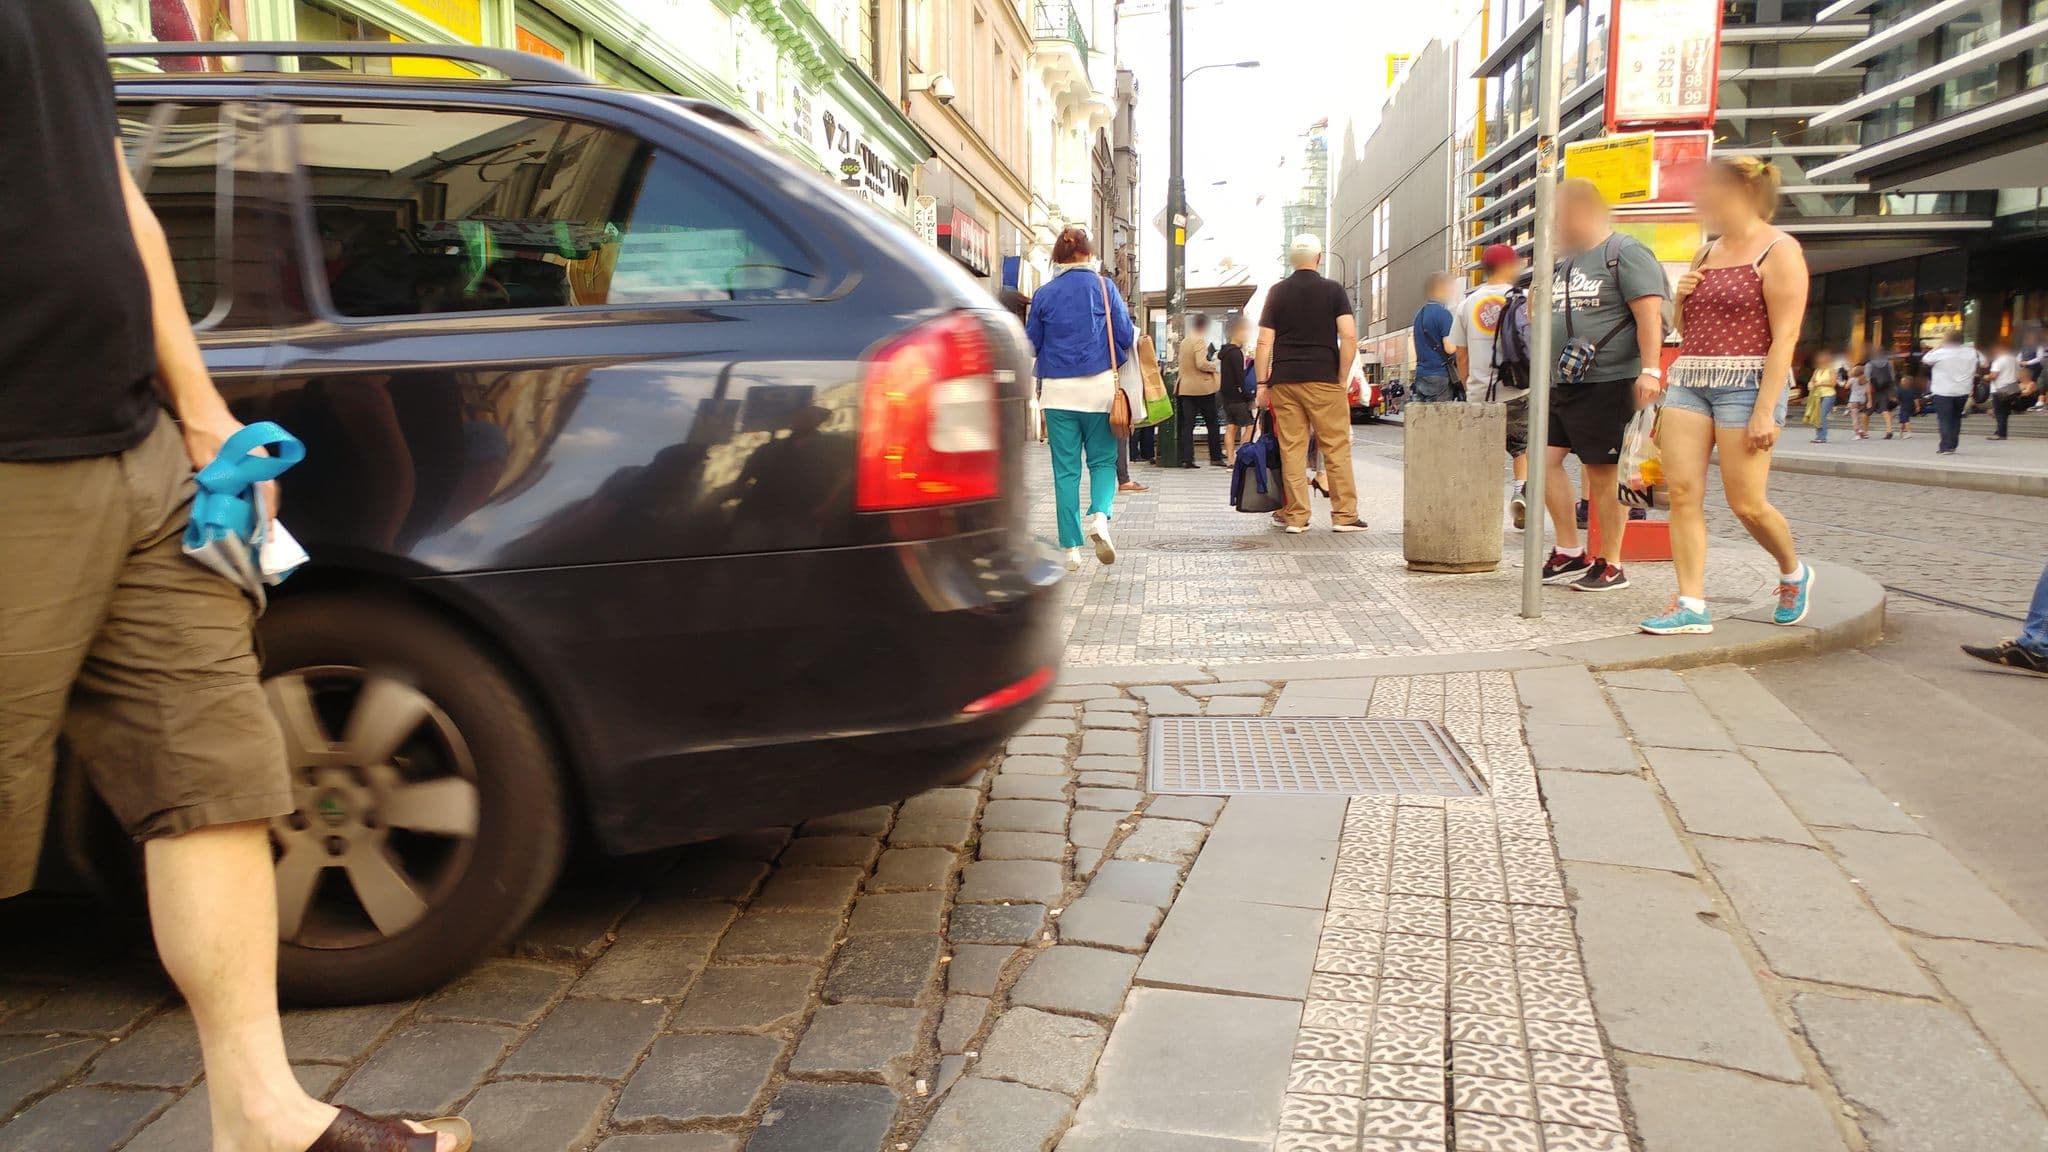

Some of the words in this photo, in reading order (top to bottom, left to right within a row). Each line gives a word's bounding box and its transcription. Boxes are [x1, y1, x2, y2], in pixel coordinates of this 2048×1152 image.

[1658, 59, 1675, 71] 22
[1657, 76, 1674, 88] 23
[1685, 75, 1702, 88] 98
[1684, 90, 1702, 104] 99
[841, 165, 860, 173] UGO
